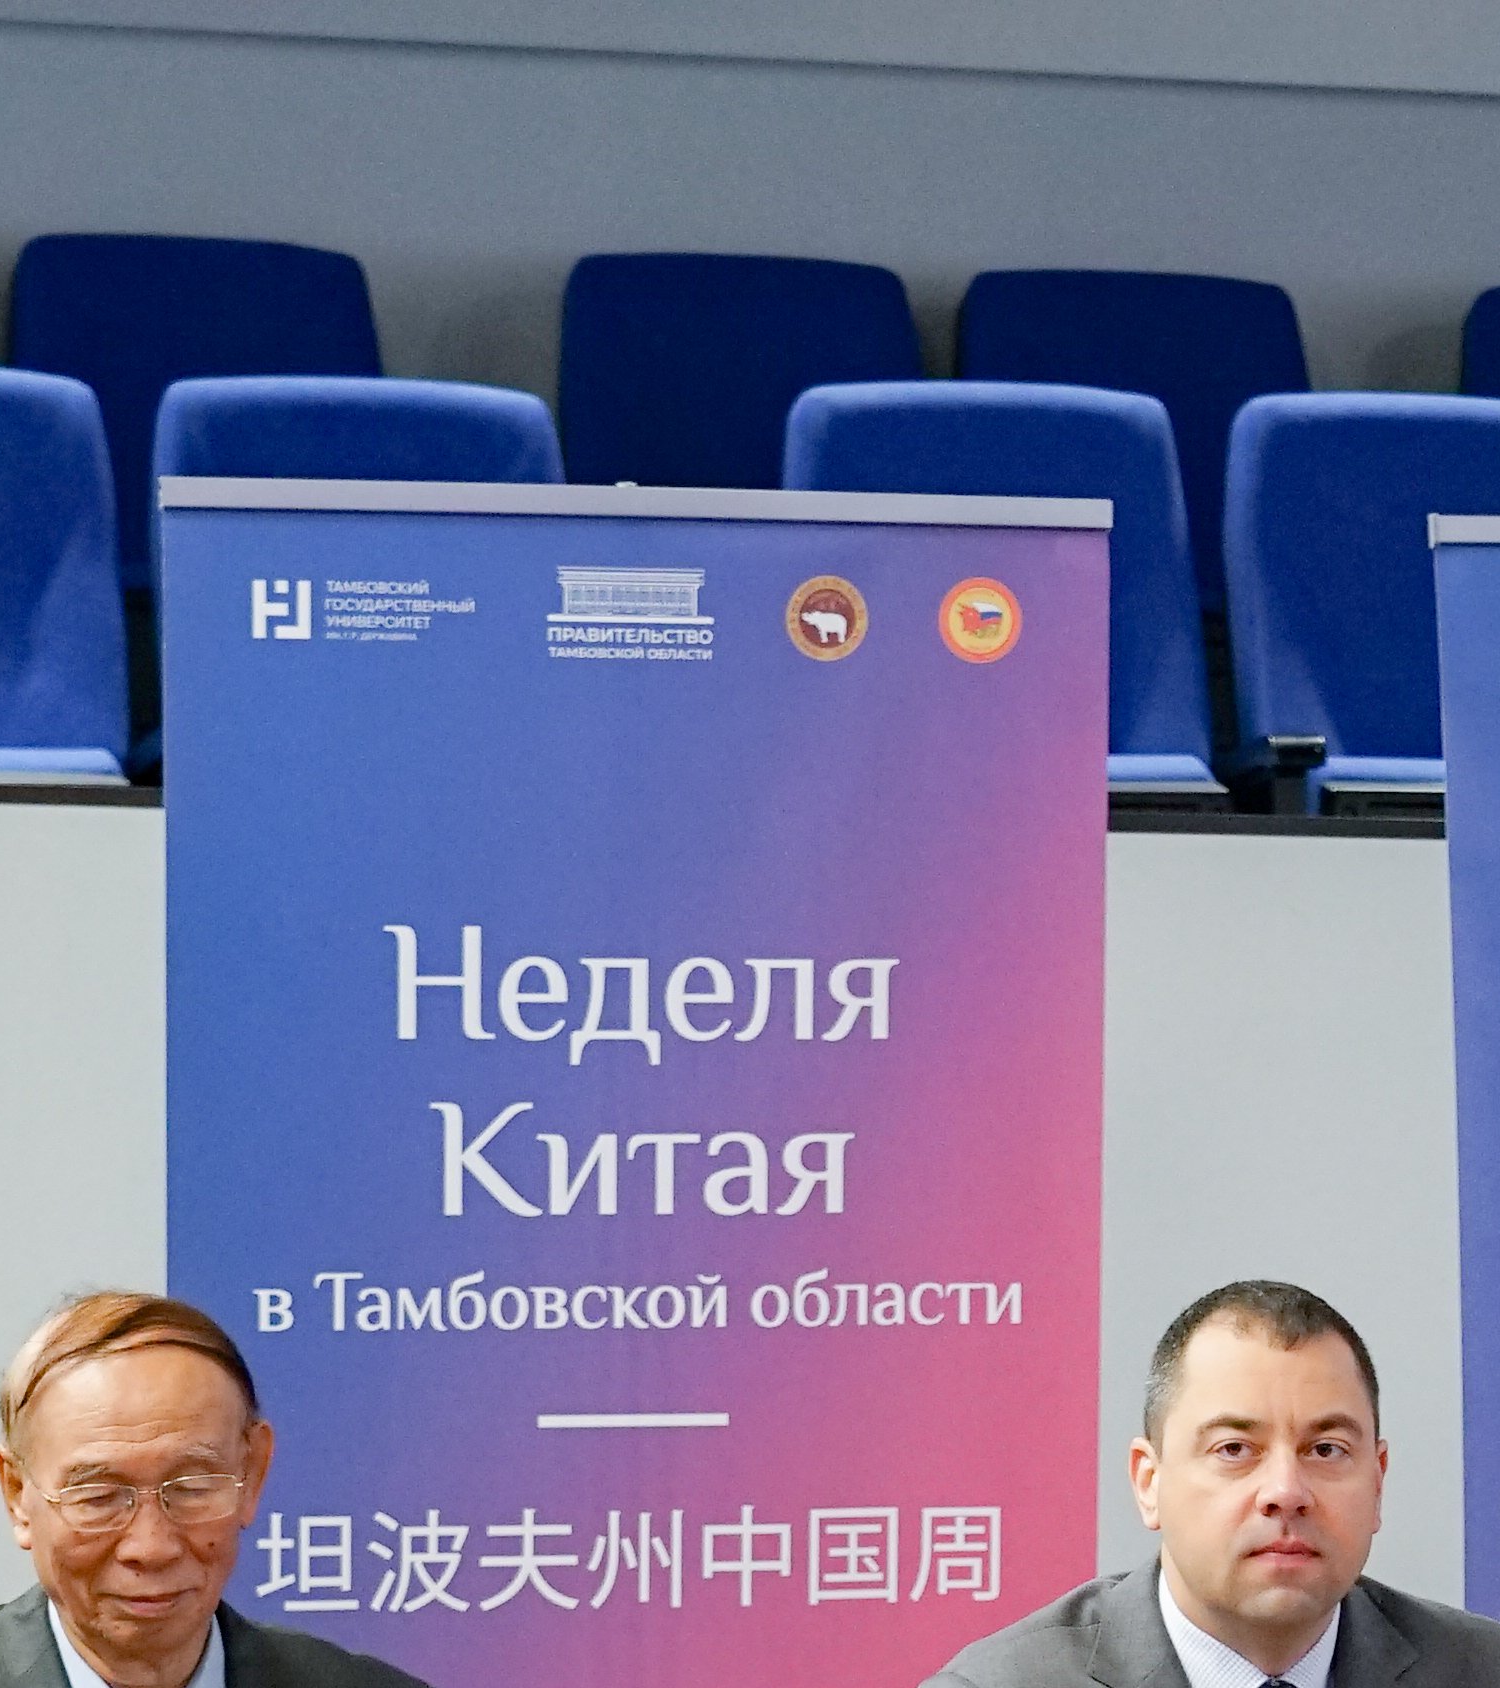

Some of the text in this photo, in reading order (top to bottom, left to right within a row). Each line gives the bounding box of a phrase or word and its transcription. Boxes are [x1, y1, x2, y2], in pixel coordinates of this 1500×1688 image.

[326, 579, 430, 595] ТАМБОВСКИЙ
[324, 598, 476, 613] ГОСУДАРСТВЕННЫЙ
[325, 615, 431, 630] УНИВЕРСИТЕТ
[547, 626, 714, 644] ПРАВИТЕЛЬСТВО
[548, 646, 713, 660] ТАМБОВСКОЙ ОБЛАСТИ
[384, 925, 900, 1066] Неделя
[430, 1102, 856, 1218] Китая
[254, 1268, 1024, 1332] в Тамбовской области
[256, 1504, 1002, 1613] 坦波夫州中国周
